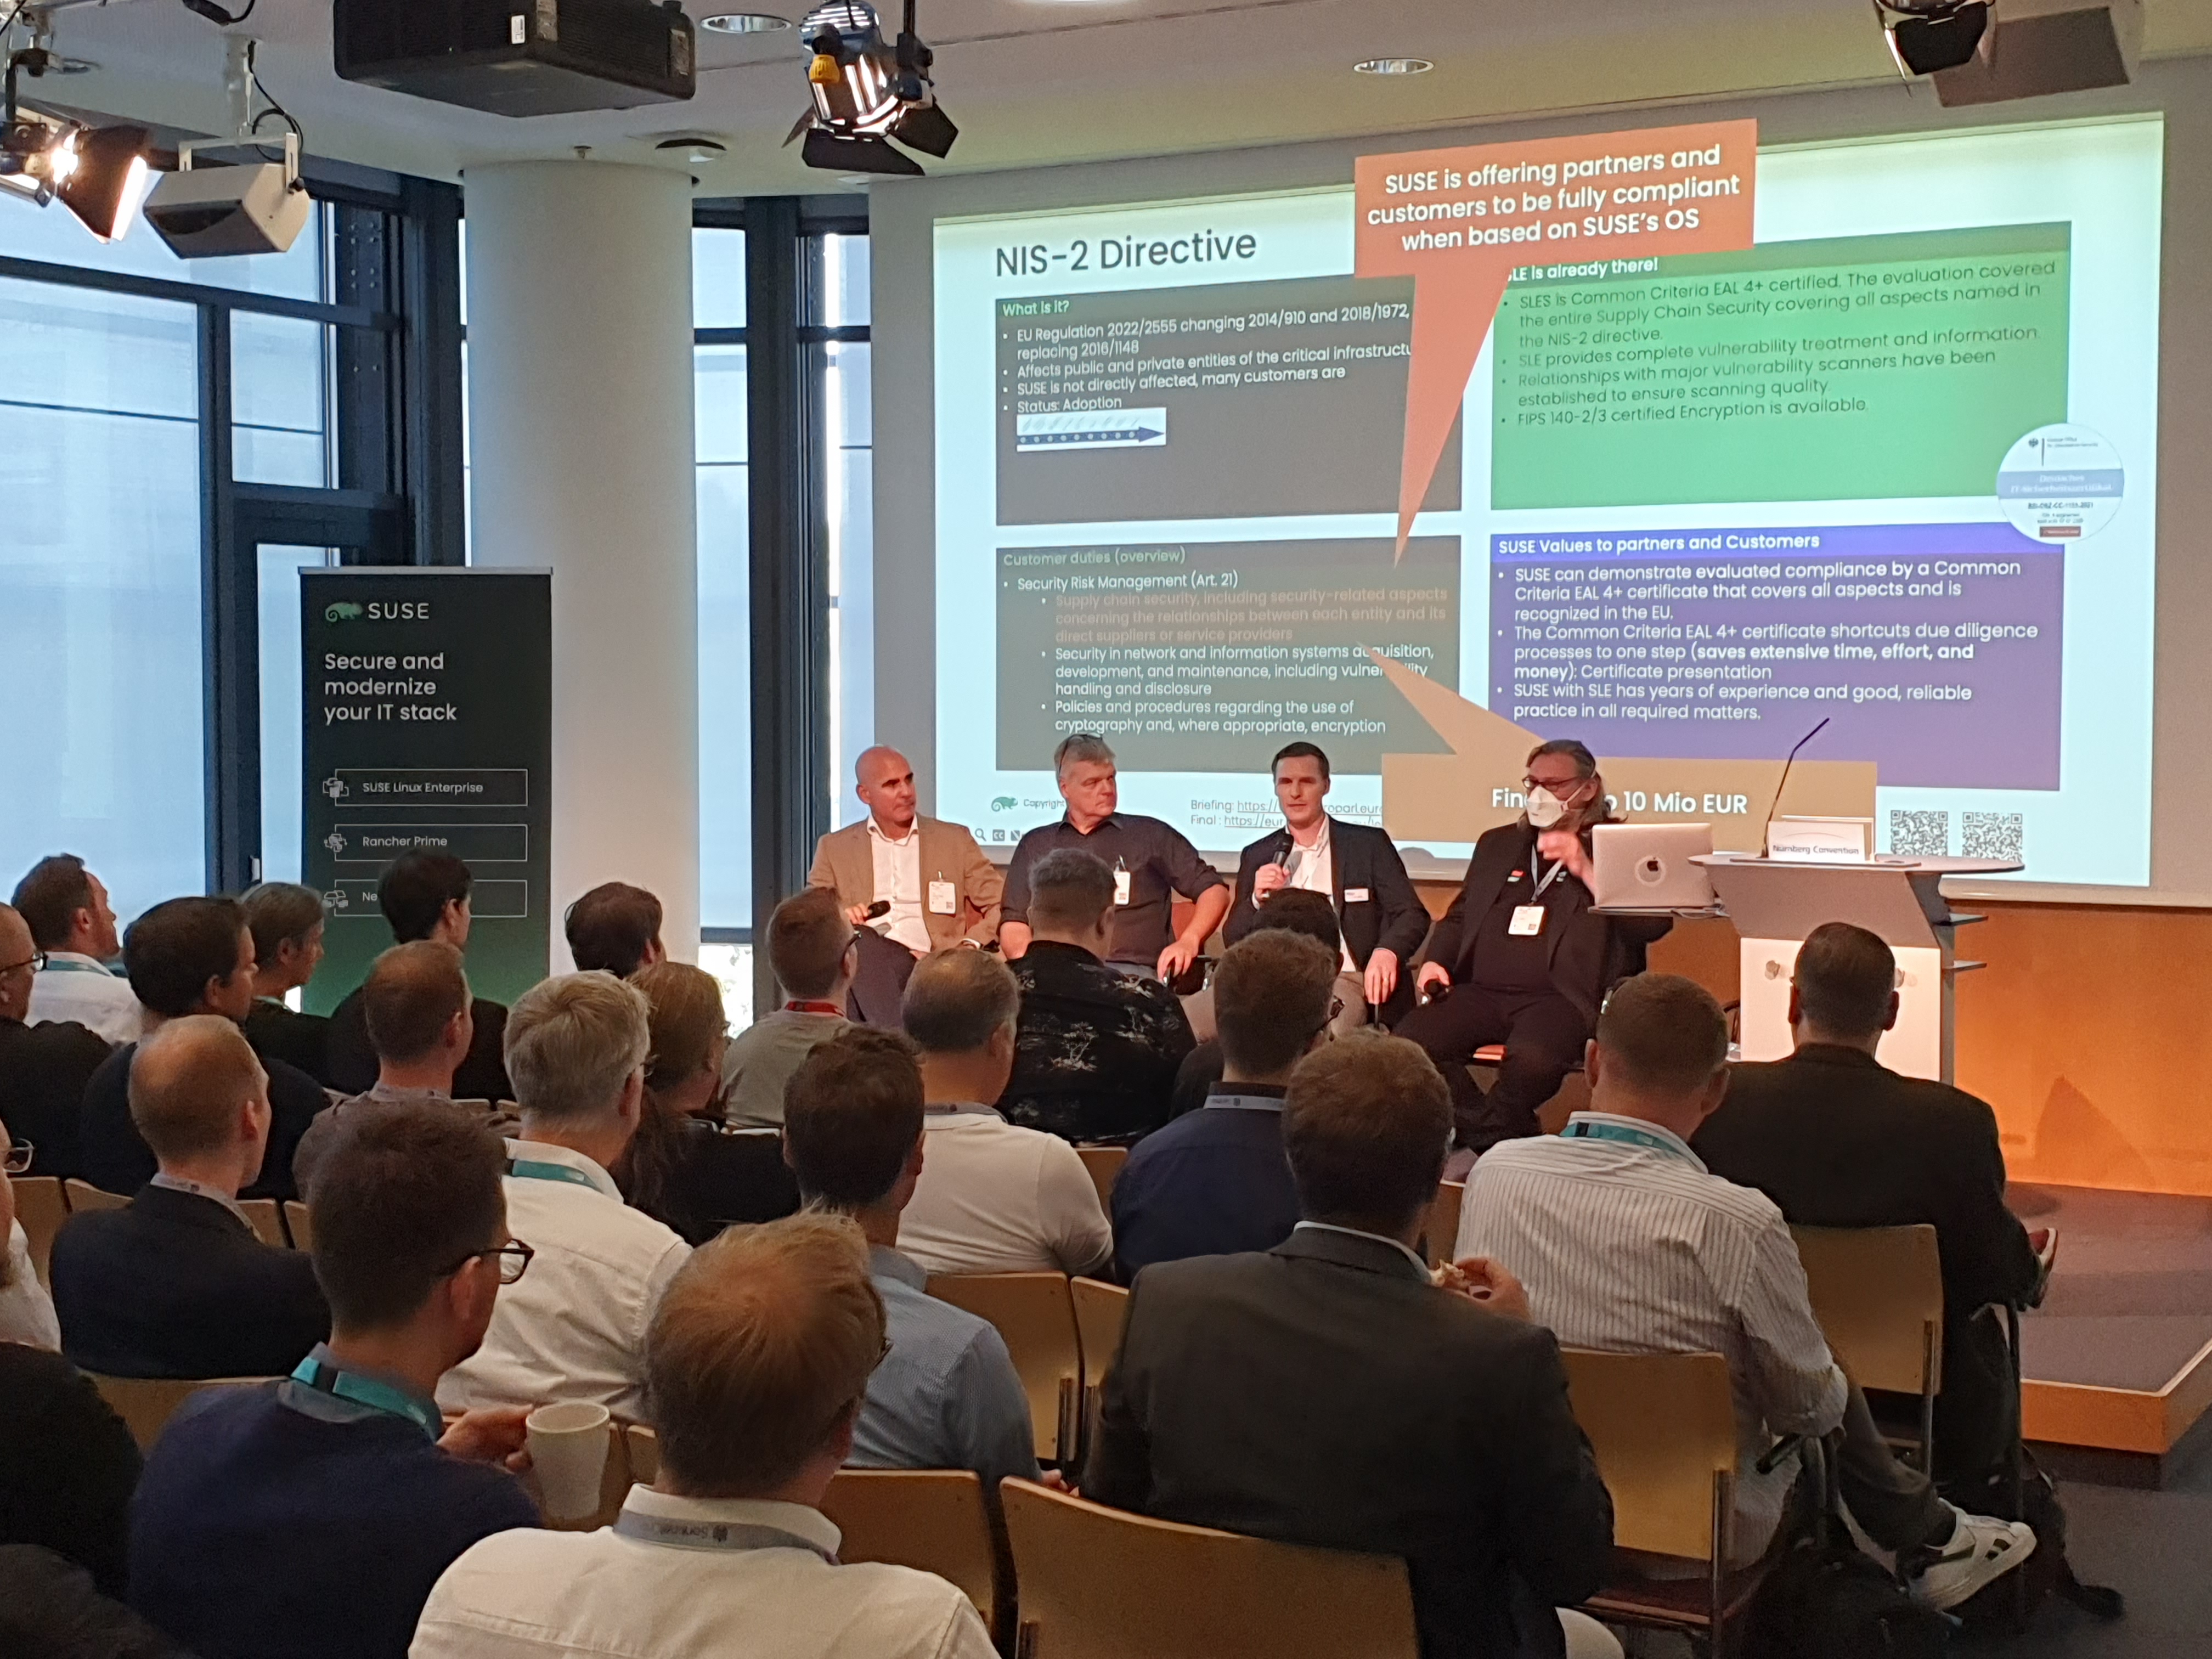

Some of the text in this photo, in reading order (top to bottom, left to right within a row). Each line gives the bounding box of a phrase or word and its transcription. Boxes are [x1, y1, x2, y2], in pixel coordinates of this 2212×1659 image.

[1386, 145, 1719, 194] SUSE is offering partners and
[1368, 176, 1740, 225] customers to be fully compliant
[1402, 228, 1462, 250] when
[1469, 219, 1541, 245] based
[1548, 222, 1576, 239] on
[1665, 207, 1699, 229] OS
[997, 233, 1256, 276] NIS-2 Directive
[1508, 258, 1657, 282] LE is already there!
[1003, 299, 1069, 316] What is it?
[1018, 326, 1032, 342] EU
[1036, 323, 1103, 343] Regulation
[1108, 318, 1177, 336] 2022/2555
[1181, 315, 1244, 334] changing
[1249, 310, 1306, 328] 2014/910
[1310, 308, 1337, 324] and
[1018, 339, 1139, 363] replacing 2016/1148
[1018, 363, 1060, 378] Affects
[1065, 359, 1103, 379] public
[1108, 358, 1133, 373] and
[1138, 356, 1184, 375] private
[1188, 352, 1235, 368] entities
[1239, 351, 1252, 365] of
[1257, 349, 1278, 364] the
[1283, 346, 1329, 363] critical
[1018, 368, 1345, 396] SUSE is not directly affected, many customers are
[1018, 396, 1121, 413] Status: Adoption
[1499, 535, 1819, 554] SUSE Values to partners and Customers
[1003, 548, 1185, 566] Customer duties (overview)
[1018, 569, 1238, 591] Security Risk Management (Art. 21)
[1516, 562, 2020, 582] SUSE can demonstrate evaluated compliance by a Common
[1515, 581, 1961, 600] Criteria EAL 4+ certificate that covers all aspects and is
[369, 603, 428, 619] SUSE
[1515, 605, 1673, 623] recognized in the EU.
[1515, 624, 2038, 641] The Common Criteria EAL 4+ certificate shortcuts due diligence
[325, 653, 443, 669] Secure and
[1515, 642, 1973, 662] processes to one step (saves extensive time, effort, and
[1582, 665, 1662, 679] Certificate
[1668, 665, 1771, 682] presentation
[325, 679, 436, 695] modernize
[1056, 682, 1211, 697] handling and disclosure
[1515, 683, 1972, 702] SUSE with SLE has years of experience and good, reliable
[324, 704, 456, 724] your IT stack
[1056, 701, 1353, 716] Policies and procedures regarding the use of
[1514, 704, 1760, 721] practice in all required matters.
[363, 782, 483, 795] SUSE Linux Enterprise
[1493, 788, 1530, 808] Fin
[1624, 792, 1646, 811] 10
[1655, 792, 1696, 812] Mio
[1703, 794, 1747, 814] EUR
[363, 836, 447, 847] Rancher Prime
